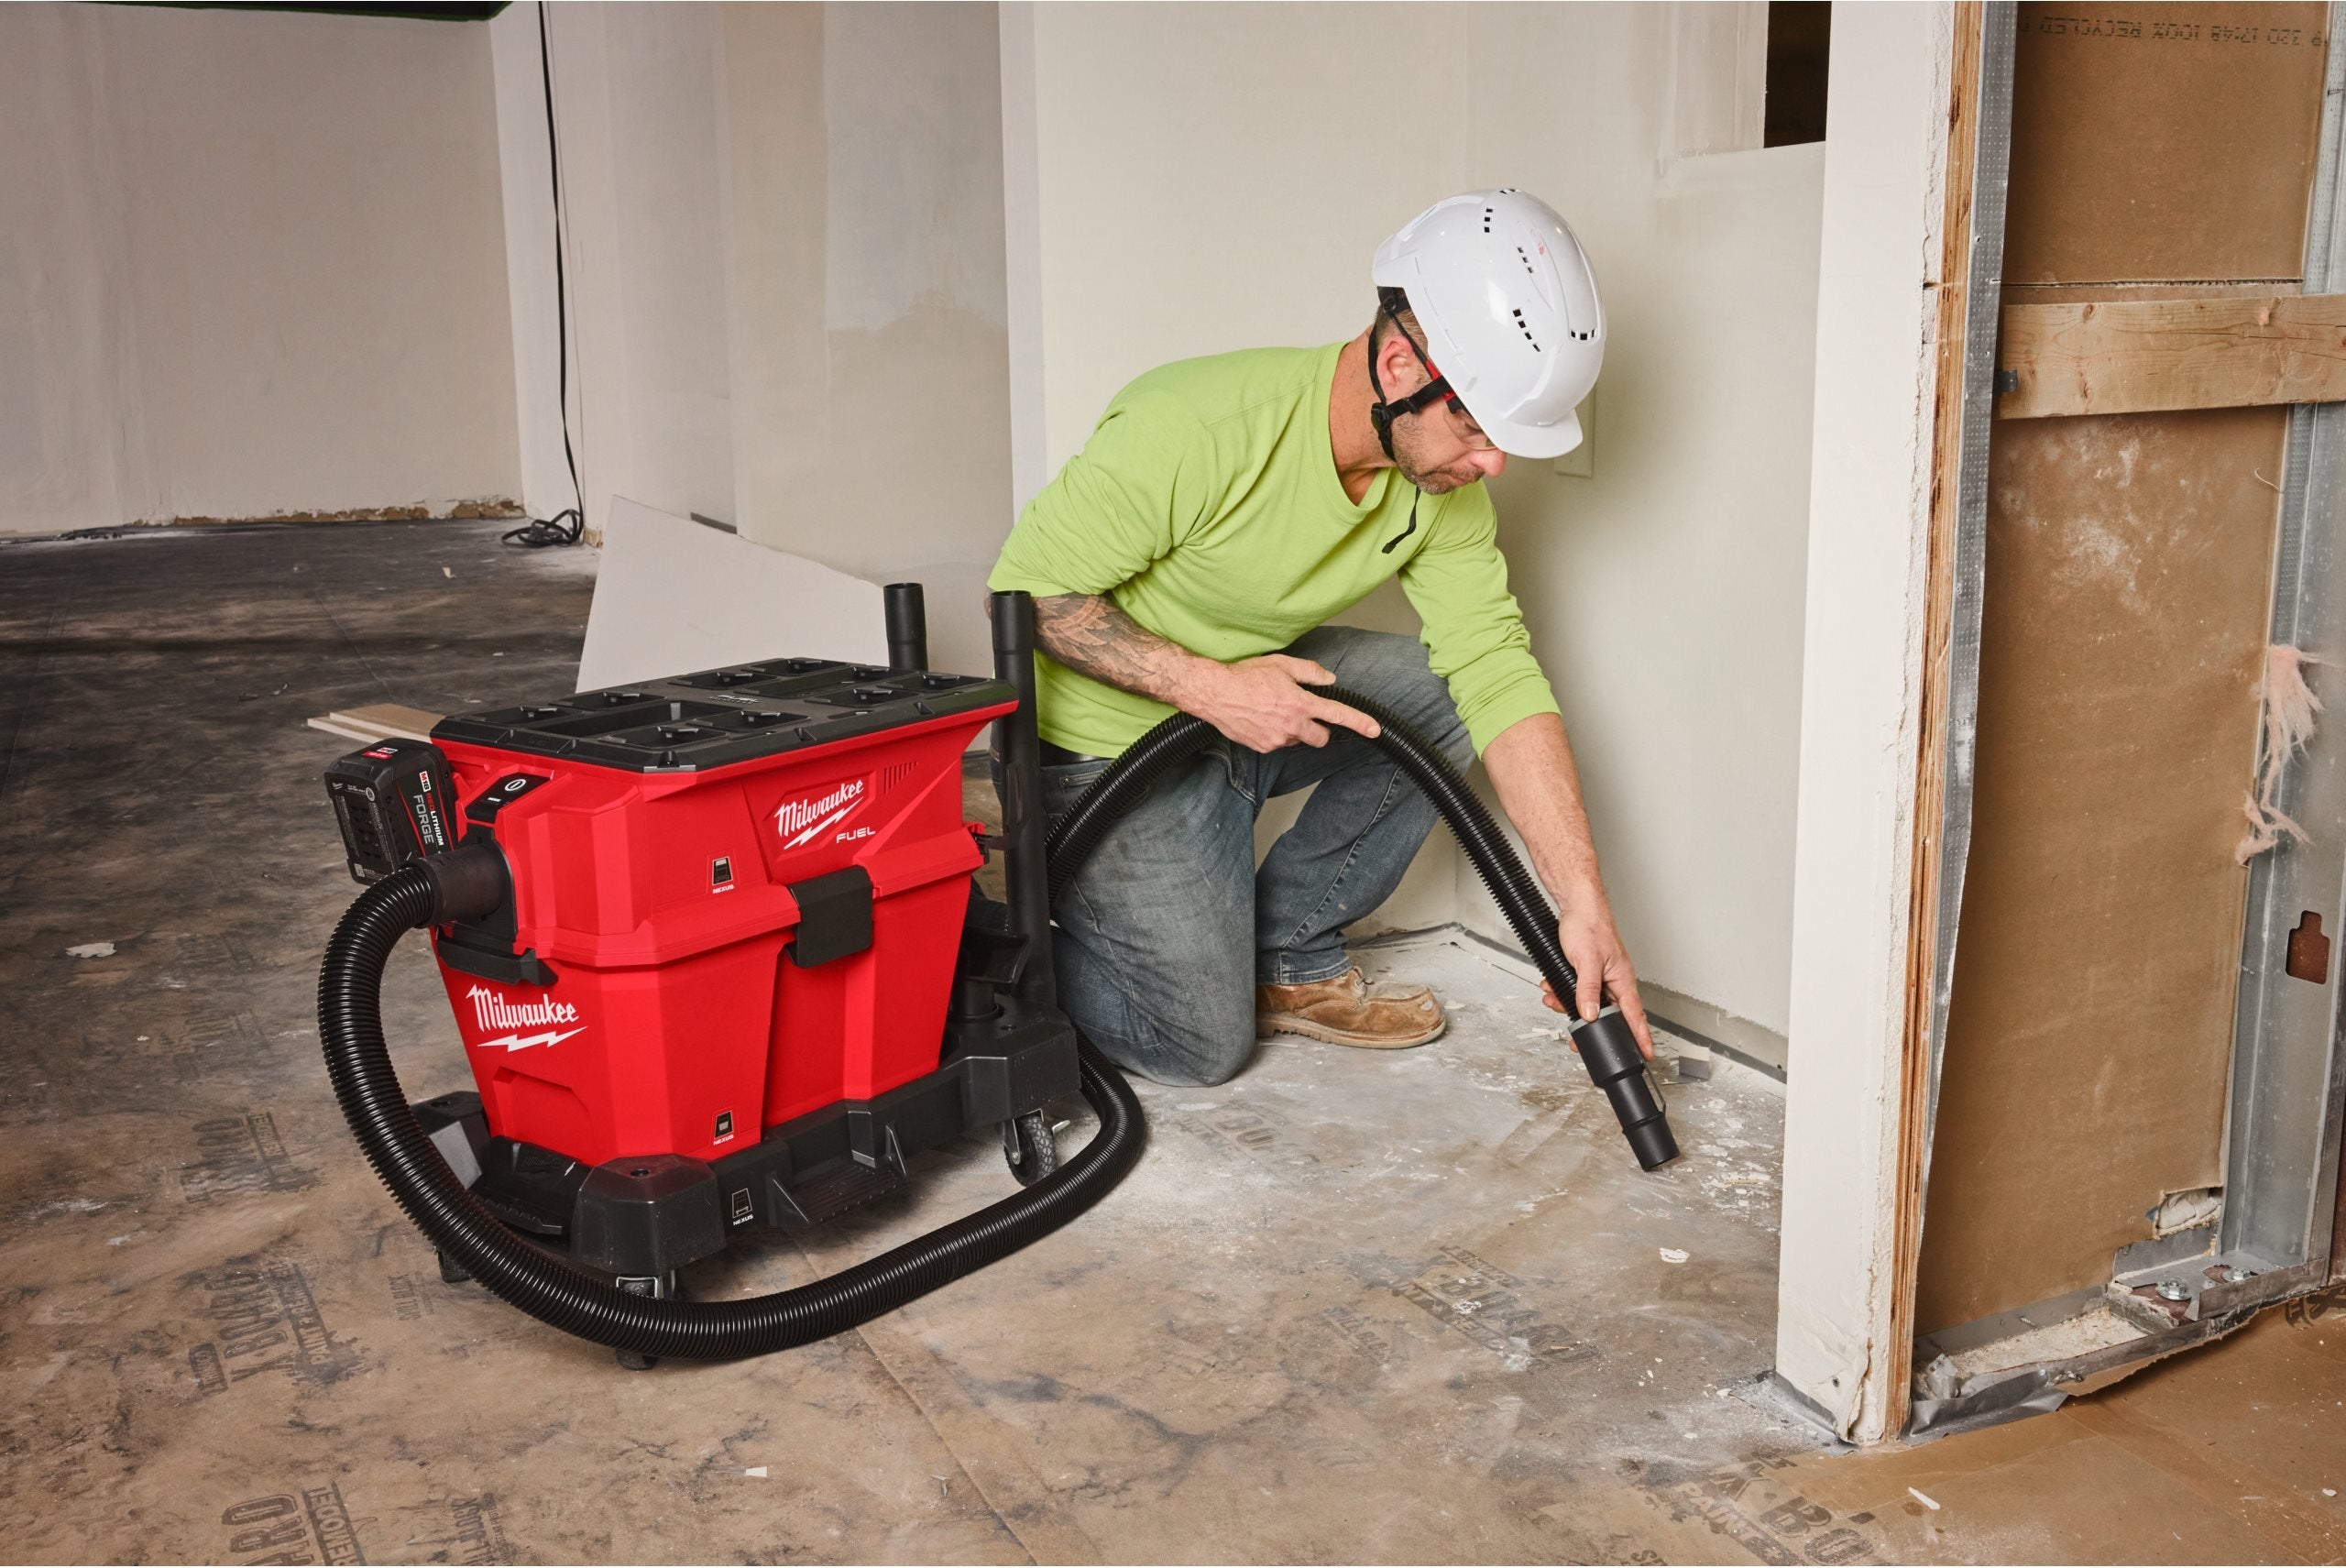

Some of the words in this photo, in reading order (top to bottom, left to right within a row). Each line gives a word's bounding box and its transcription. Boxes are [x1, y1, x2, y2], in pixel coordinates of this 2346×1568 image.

[2039, 16, 2142, 38] RECYCLED
[773, 779, 864, 837] Milwaukee
[413, 794, 435, 844] FORGE
[836, 826, 876, 843] FUEL
[712, 883, 734, 894] NEXUS
[466, 983, 580, 1033] Milwaukee
[713, 1134, 734, 1146] NEXUS
[733, 1213, 753, 1226] NEXUS
